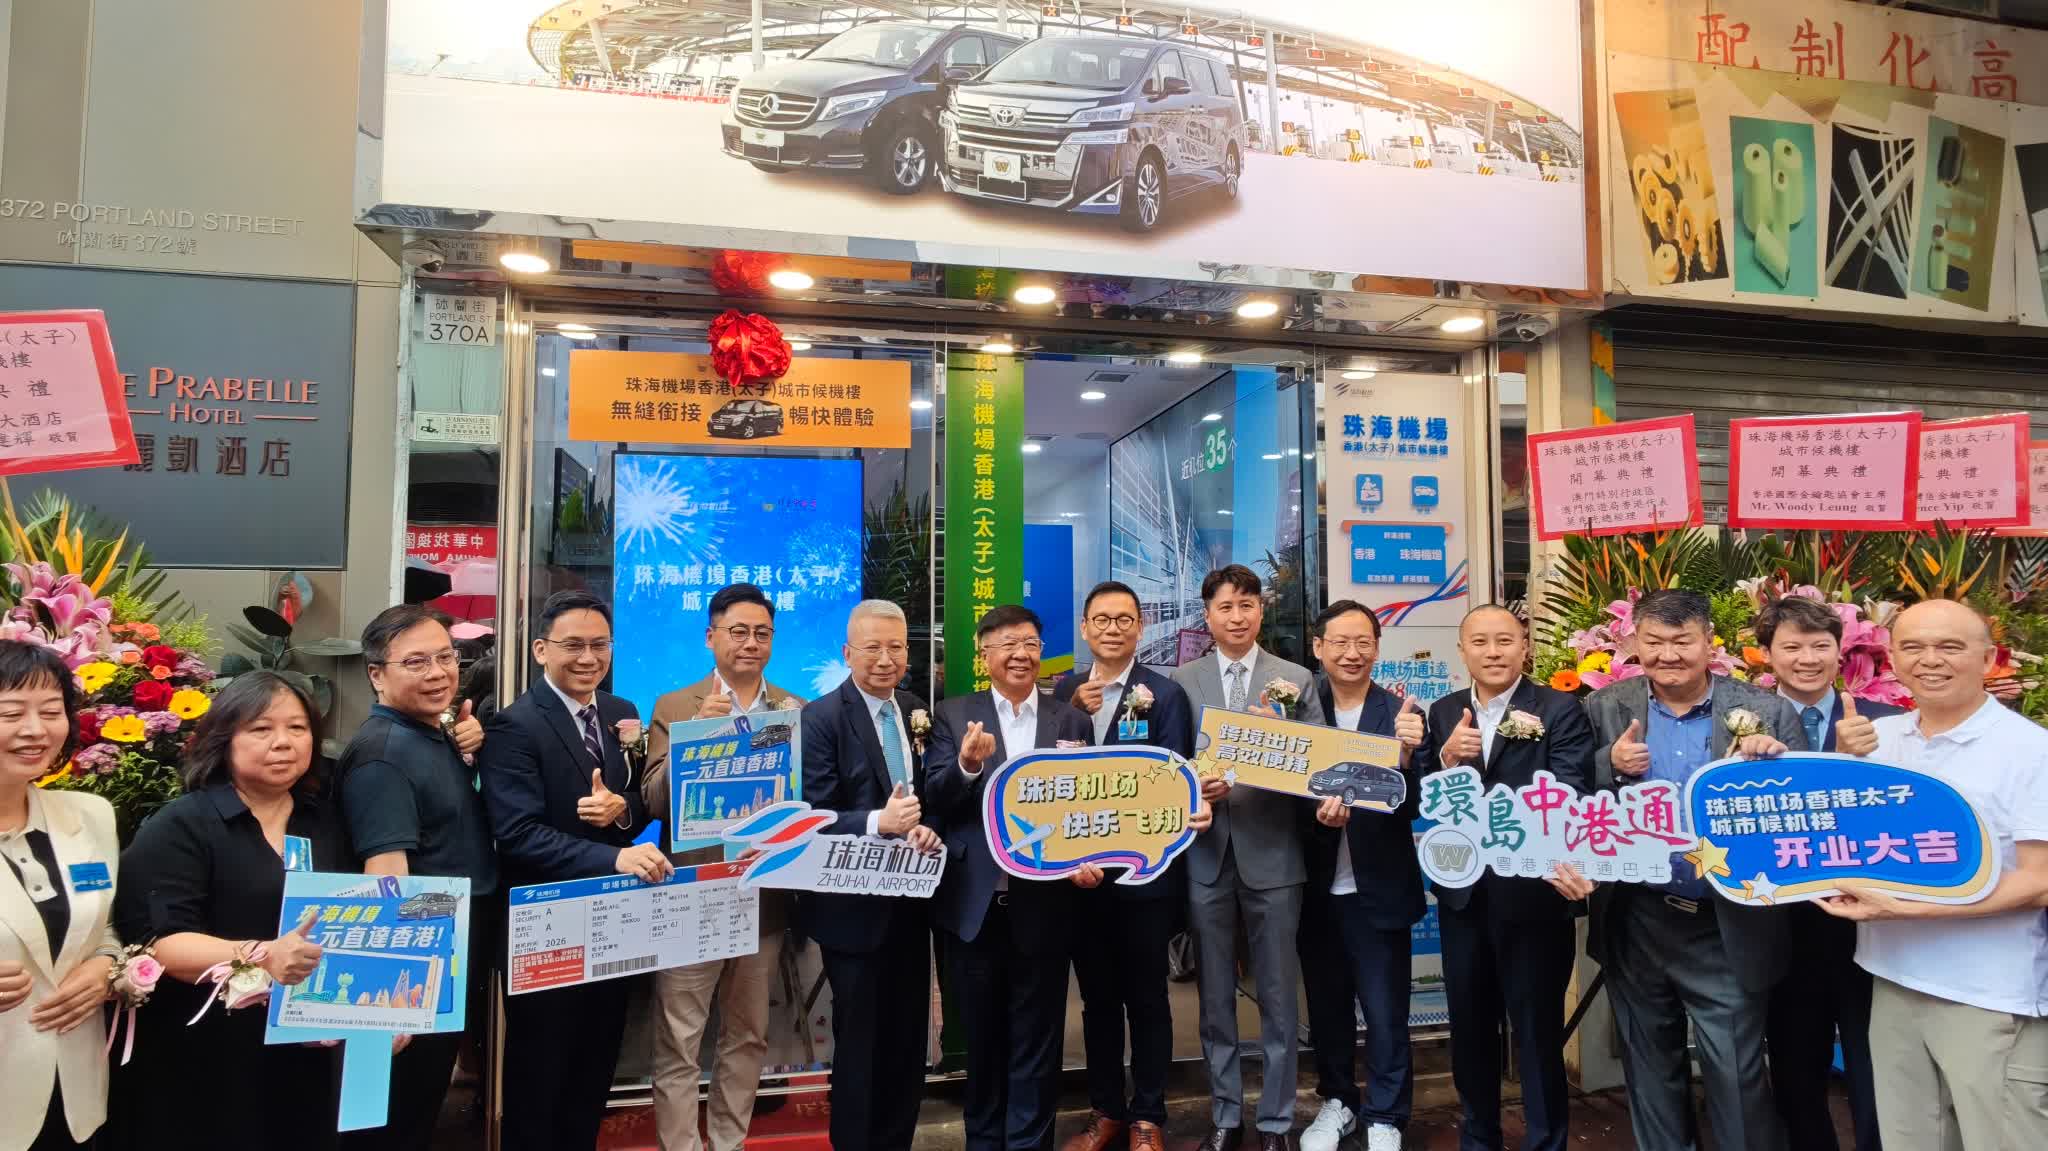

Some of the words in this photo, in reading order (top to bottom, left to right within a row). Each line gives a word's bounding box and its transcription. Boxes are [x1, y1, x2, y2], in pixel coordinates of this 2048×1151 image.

[0, 199, 45, 219] 372
[52, 202, 195, 228] PORTLAND
[202, 212, 304, 236] STREET
[430, 312, 475, 322] PORTLAND
[480, 315, 494, 325] ST
[430, 323, 488, 343] 370A
[0, 327, 77, 345] (太子)
[149, 367, 320, 405] PRABELLE
[168, 401, 247, 424] HOTEL
[1343, 413, 1449, 441] 珠海機場
[1918, 466, 1979, 480] 典禮
[1751, 502, 1770, 511] Mr.
[1775, 501, 1815, 513] Woody
[1819, 502, 1857, 513] Leung
[1917, 502, 1939, 511] nce
[1943, 503, 1964, 512] Yip
[1218, 722, 1312, 755] 跨境出行
[1215, 743, 1310, 775] 高效便捷
[1017, 770, 1139, 803] 珠海机场
[1705, 784, 1914, 817] 珠海机场香港太子
[1062, 806, 1183, 839] 快乐飞翔
[1424, 771, 1692, 857] 環島中港通
[1709, 811, 1838, 836] 城市候机楼
[822, 840, 942, 876] 珠海机场
[1428, 843, 1471, 873] W
[1773, 829, 1960, 869] 开业大吉
[817, 872, 870, 889] ZHUHAI
[876, 876, 935, 893] AIRPORT
